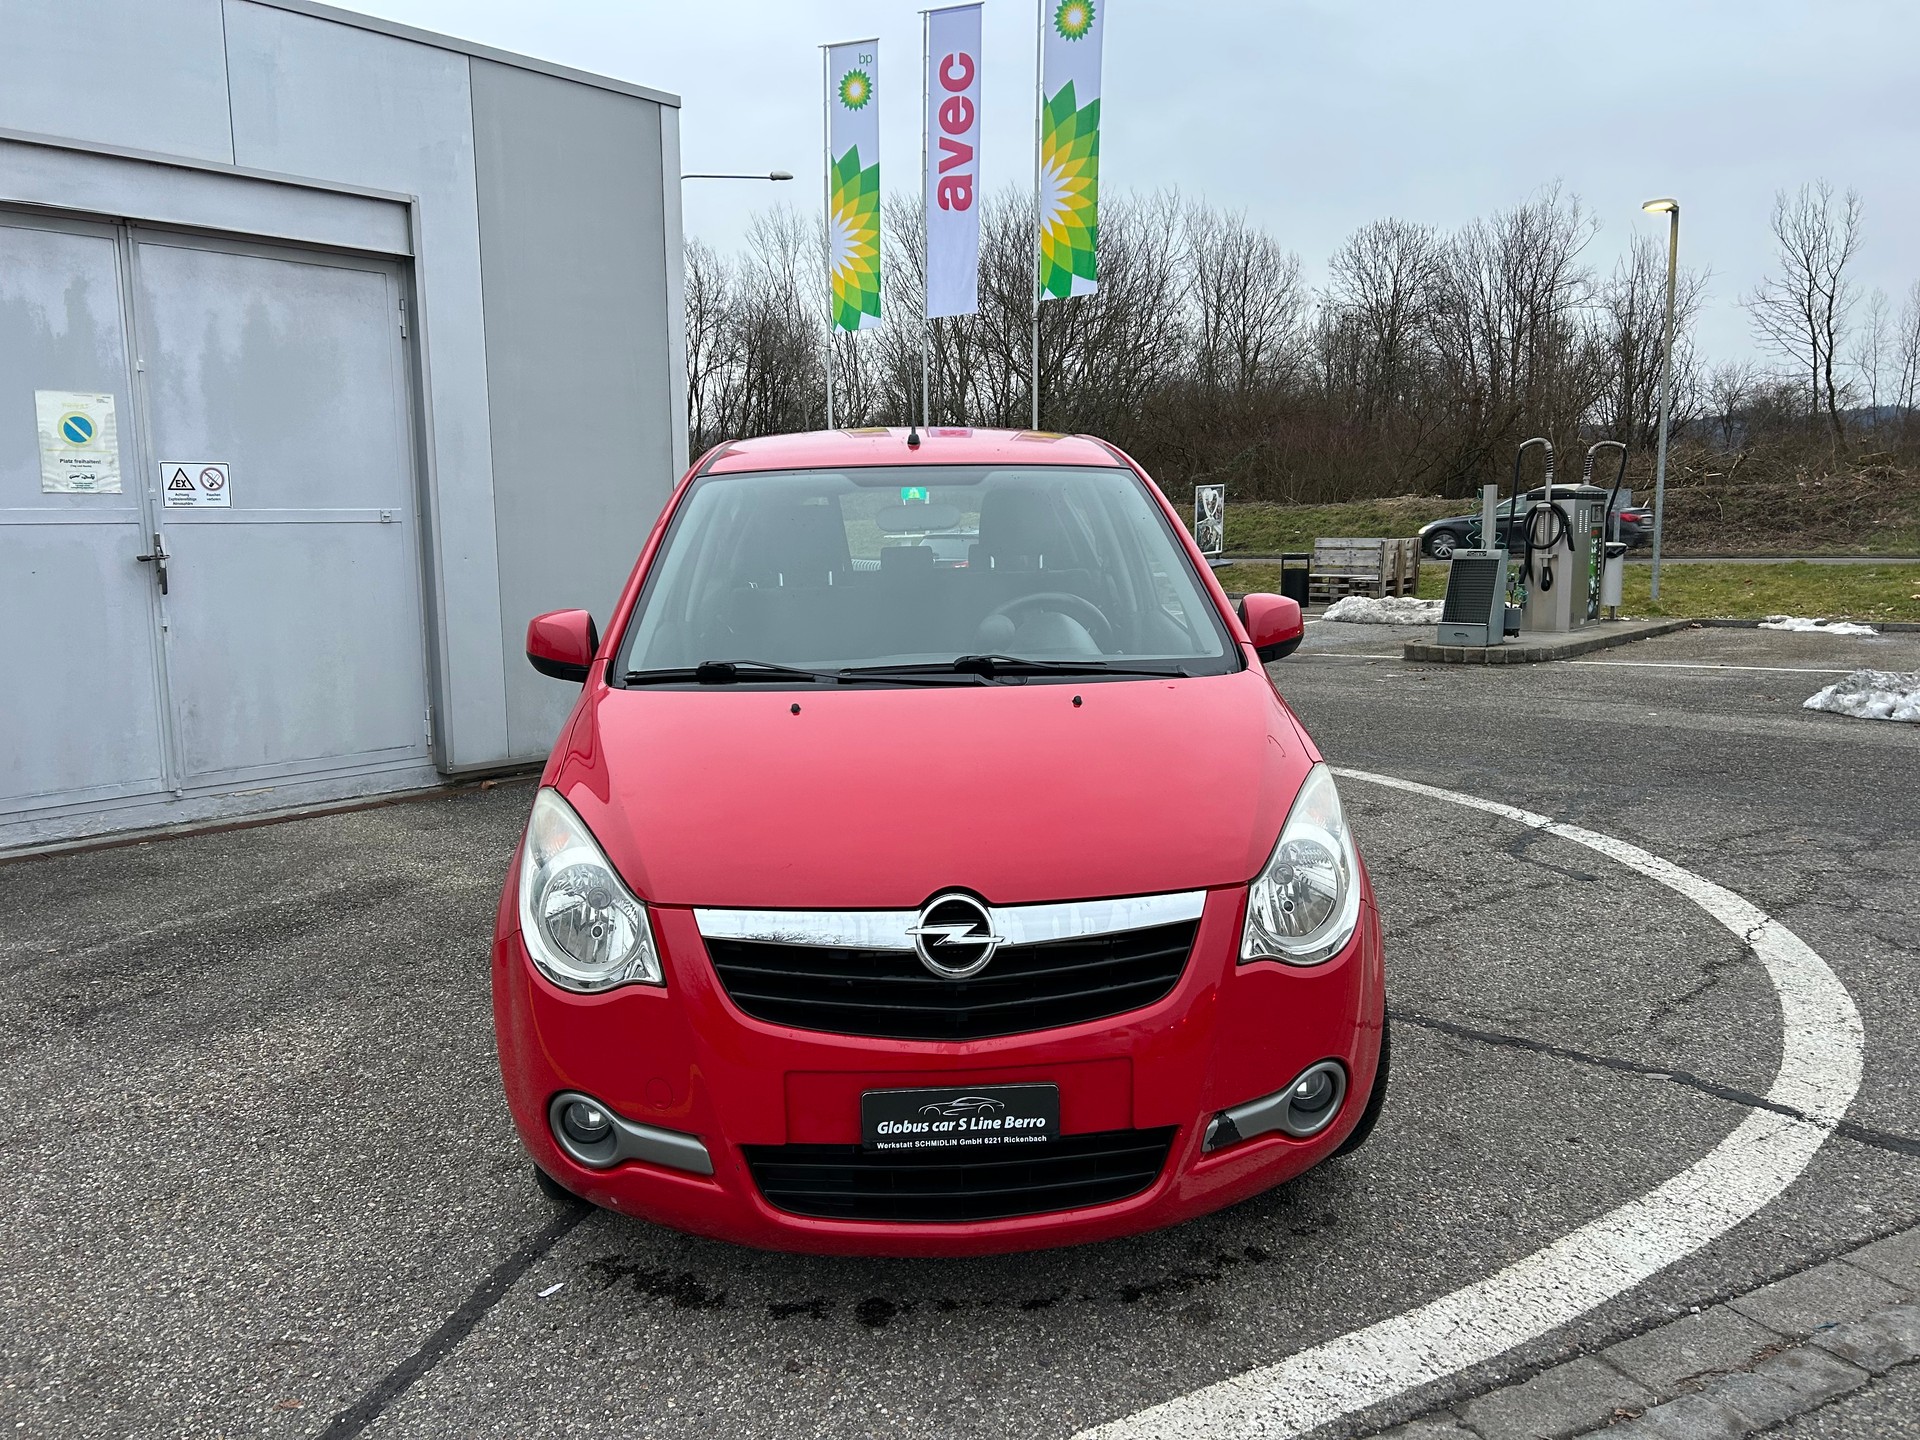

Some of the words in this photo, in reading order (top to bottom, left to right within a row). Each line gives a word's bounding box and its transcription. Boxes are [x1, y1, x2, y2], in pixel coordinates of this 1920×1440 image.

[859, 53, 873, 66] bp
[937, 52, 975, 212] avec
[175, 479, 187, 488] EX
[877, 1120, 929, 1134] Globus
[931, 1121, 956, 1132] car
[957, 1117, 968, 1131] S
[970, 1116, 1002, 1130] Line
[1004, 1115, 1046, 1129] Berro
[876, 1141, 913, 1149] Werkstatt
[914, 1139, 958, 1148] SCHMIDLIN
[959, 1137, 982, 1146] GmbH
[984, 1136, 1001, 1144] 6221
[1003, 1135, 1047, 1143] Rickenbach
